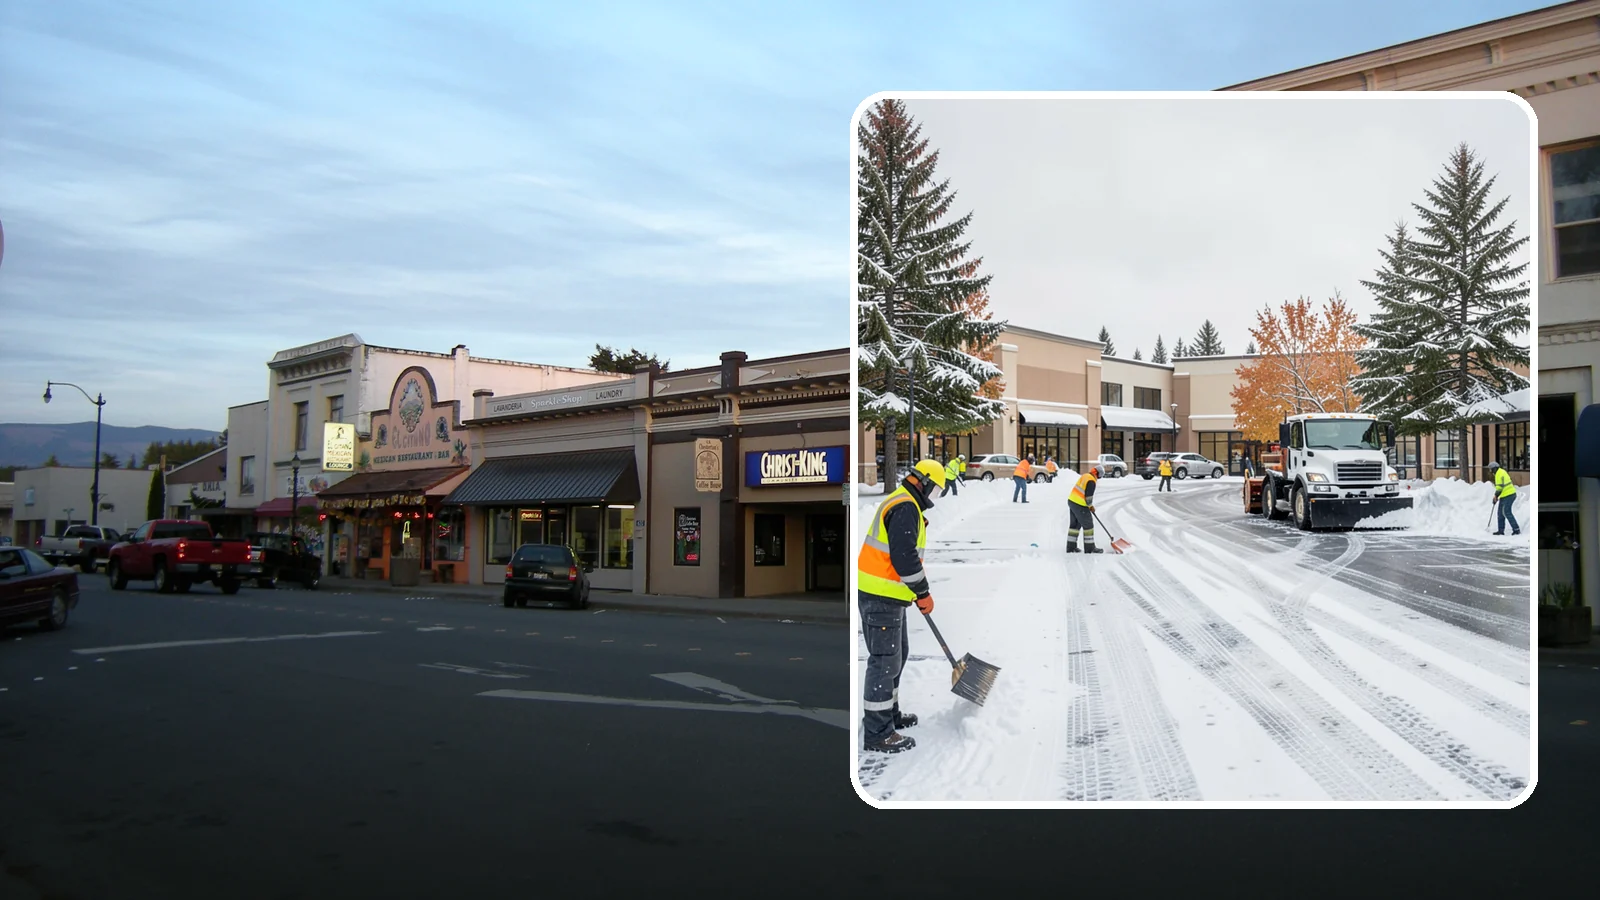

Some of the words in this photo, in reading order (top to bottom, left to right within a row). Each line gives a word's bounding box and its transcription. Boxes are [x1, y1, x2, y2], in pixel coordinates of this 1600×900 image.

[530, 396, 560, 408] Sparkle
[562, 394, 582, 404] Shop
[596, 389, 623, 400] LAUNDRY
[494, 402, 522, 412] LAVANDERIA
[374, 455, 396, 464] MEXICAN
[398, 452, 433, 462] RESTAURANT
[438, 450, 450, 459] BAR
[761, 452, 797, 477] CHRIST
[799, 450, 827, 476] KING
